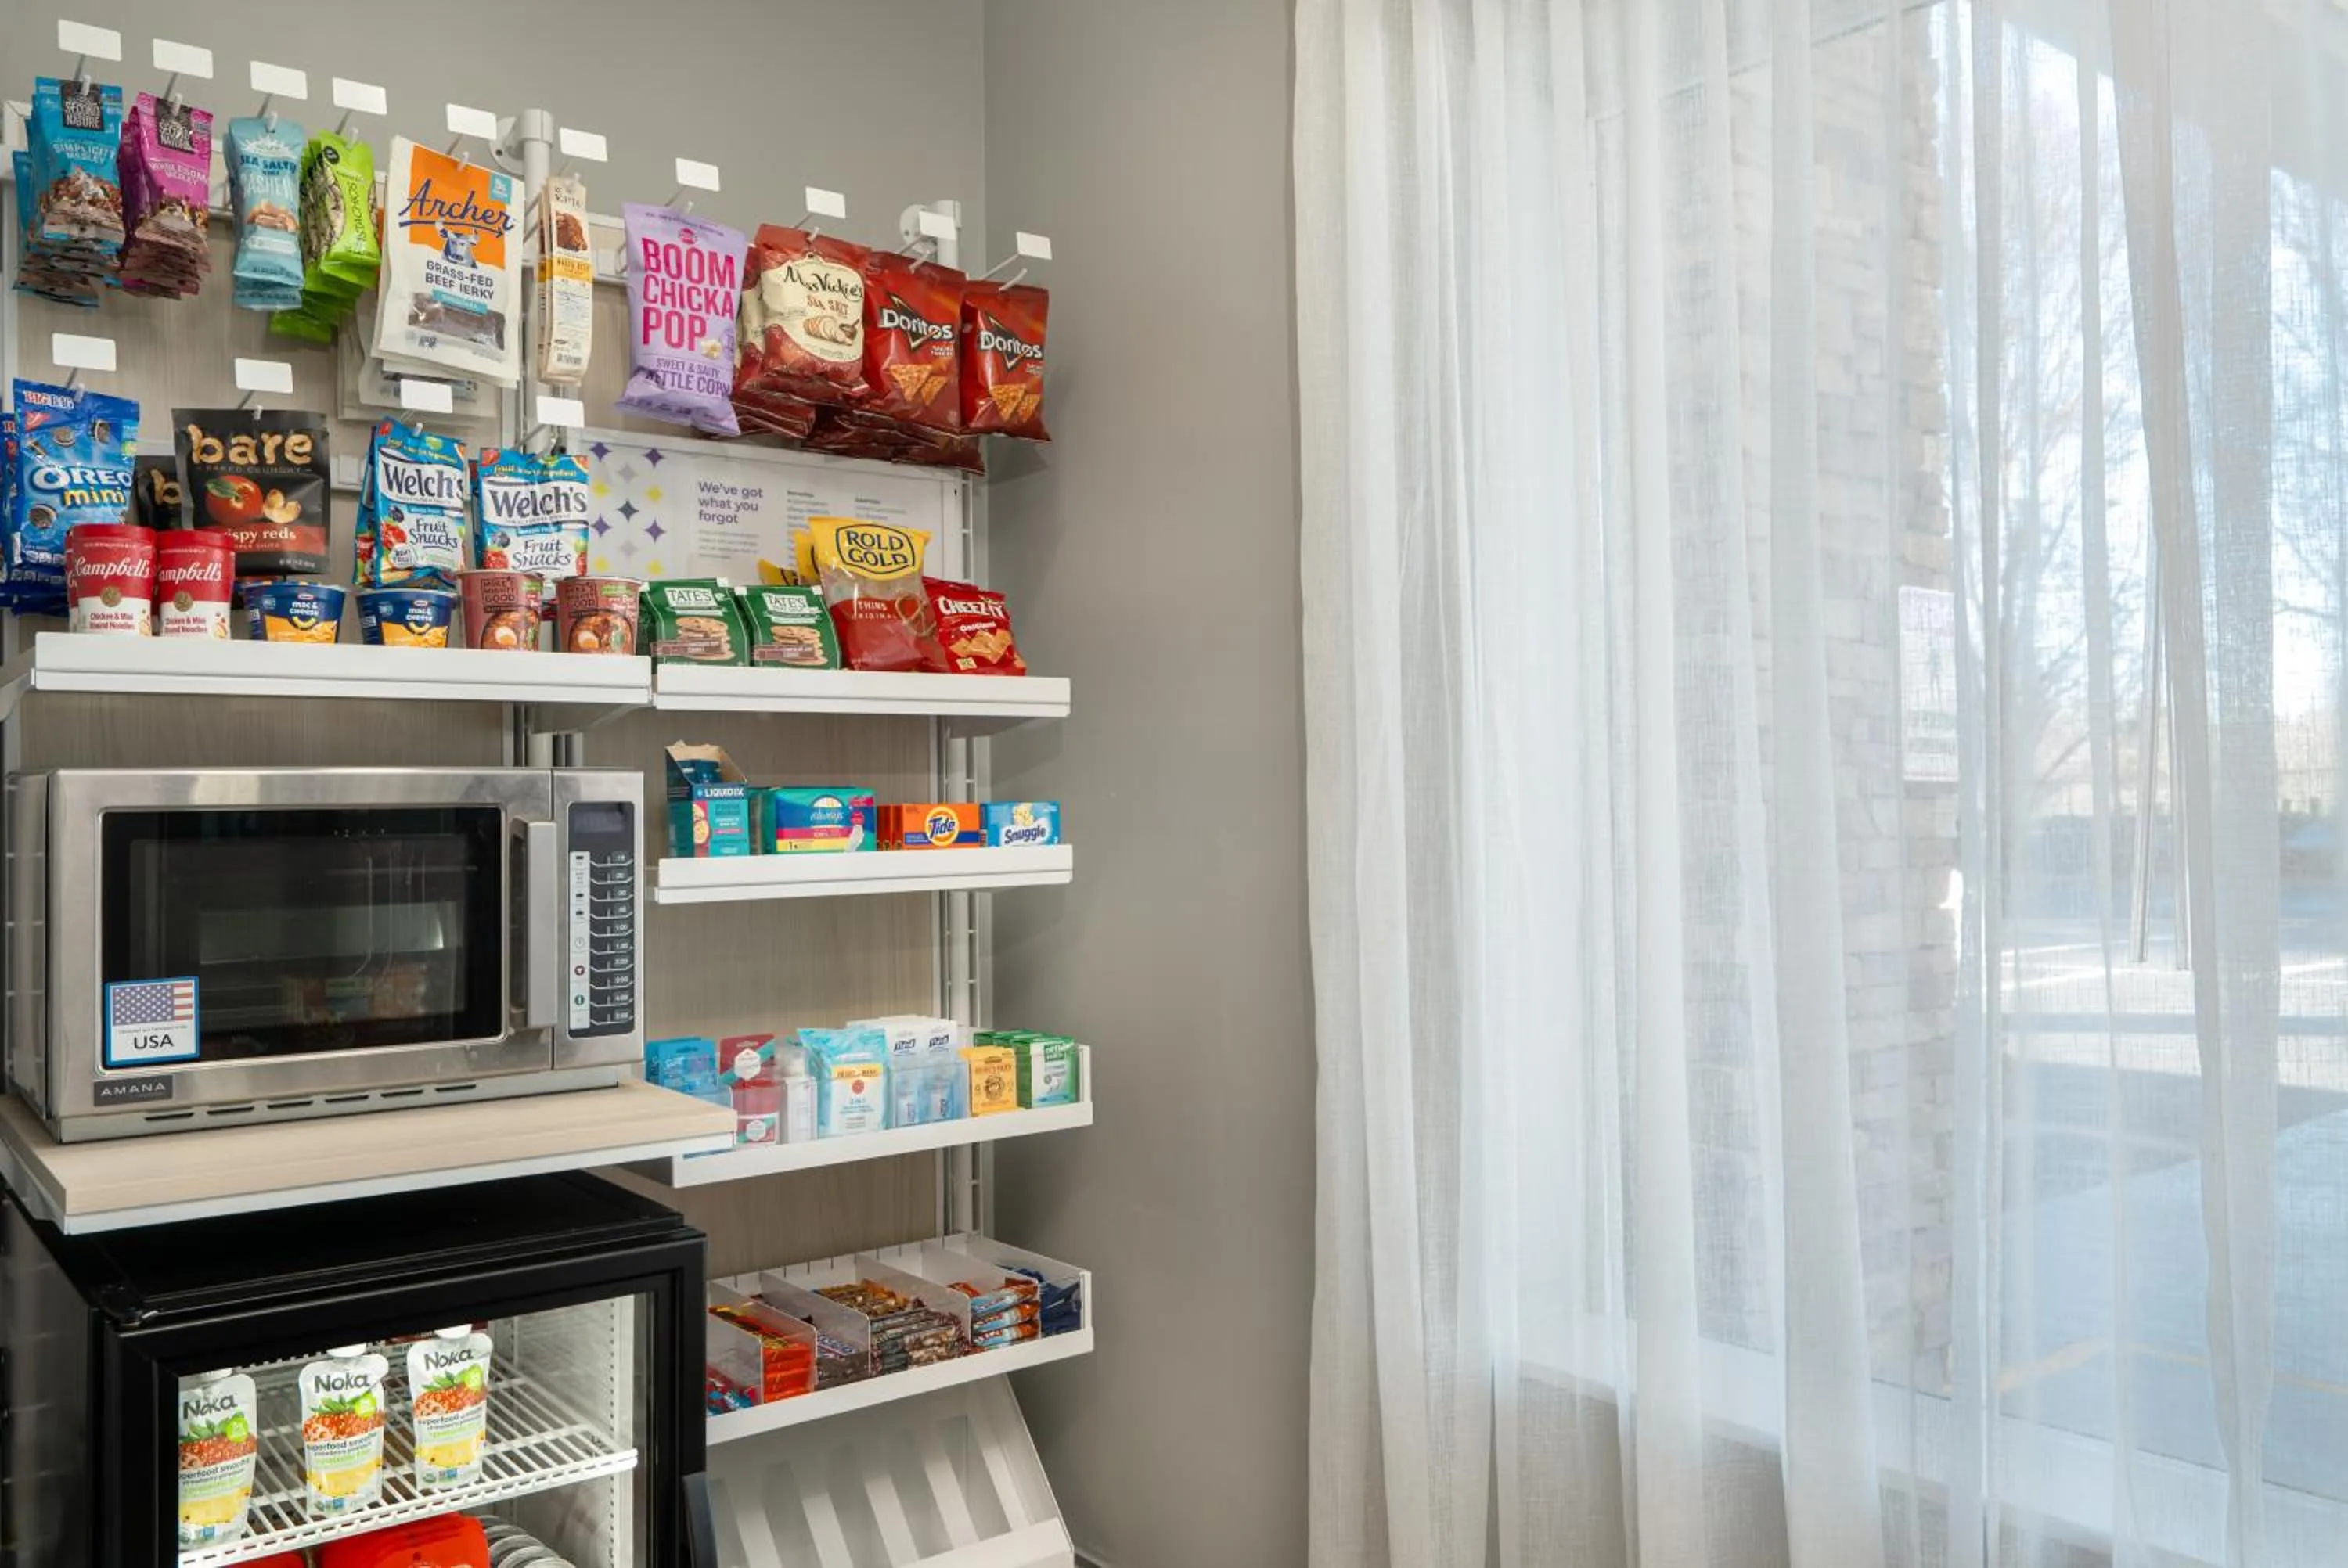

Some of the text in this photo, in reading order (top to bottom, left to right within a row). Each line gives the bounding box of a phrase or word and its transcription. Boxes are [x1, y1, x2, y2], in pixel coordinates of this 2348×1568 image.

[65, 100, 101, 117] SECOND
[67, 115, 101, 128] NATURE
[398, 177, 514, 232] Archer
[426, 259, 494, 288] GRASS-FED
[642, 237, 736, 290] BOOM
[425, 271, 495, 300] BEEF JERKY
[783, 265, 863, 302] Miss Vickie's
[643, 274, 734, 320] CHICKA
[643, 306, 707, 351] POP
[881, 307, 953, 340] Doritos
[980, 331, 1043, 359] Doritos
[656, 358, 721, 377] SWEET & SALTY
[697, 376, 731, 397] CORN
[187, 423, 313, 465] bare
[32, 465, 133, 491] OREO
[383, 462, 464, 502] Welch's
[63, 487, 126, 507] mini
[698, 481, 763, 501] We've got
[488, 485, 588, 519] Welch's
[698, 497, 758, 512] what you
[416, 518, 448, 534] Fruit
[698, 511, 739, 526] forgot
[262, 526, 297, 540] reds
[409, 527, 459, 548] Snacks
[845, 530, 905, 552] ROLD
[524, 538, 564, 552] Fruit
[74, 556, 149, 579] Campbell's
[513, 551, 572, 568] Snacks
[848, 548, 909, 567] GOLD
[159, 561, 223, 584] ampbell's
[668, 589, 713, 602] TATE'S
[765, 594, 806, 609] TATE'S
[90, 612, 113, 620] Chicken
[704, 786, 733, 798] LIQUID
[927, 814, 956, 840] Tide
[1003, 825, 1047, 844] Snuggle
[133, 1033, 175, 1050] USA
[101, 1081, 166, 1096] AMANA
[423, 1349, 474, 1371] Noka
[314, 1372, 370, 1394] Noka
[182, 1393, 239, 1420] Noka
